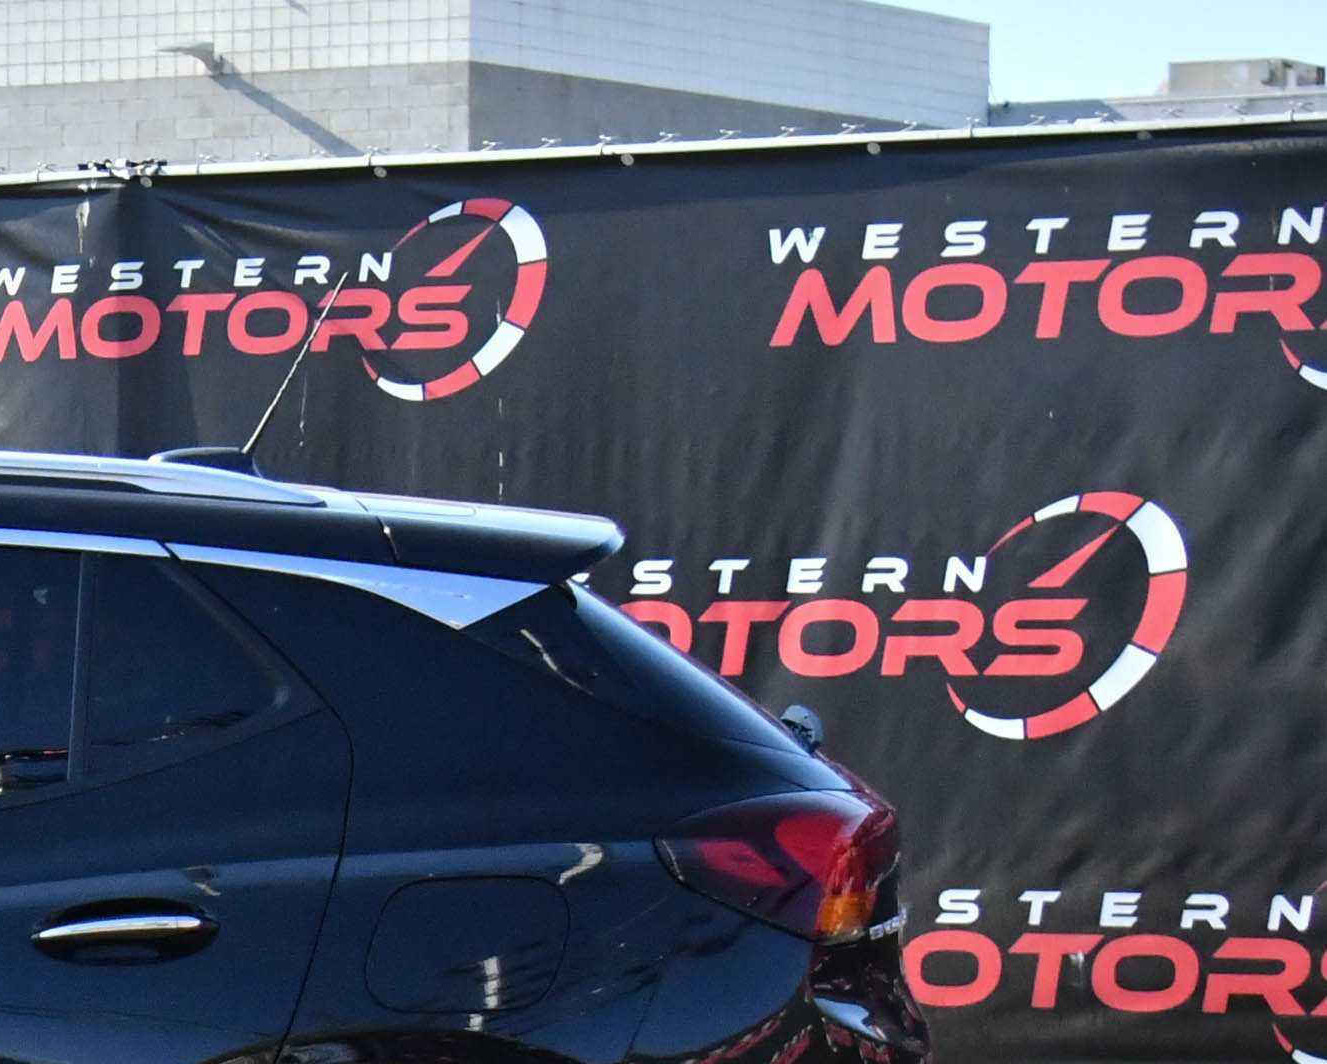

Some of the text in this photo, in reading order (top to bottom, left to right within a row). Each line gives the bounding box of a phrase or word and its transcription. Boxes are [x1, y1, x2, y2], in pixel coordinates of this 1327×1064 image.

[769, 207, 1325, 264] WESTERN
[770, 252, 1327, 347] MOTOR
[569, 557, 988, 594] STERN
[936, 890, 1313, 931] STERN
[901, 929, 1327, 1017] OTOR
